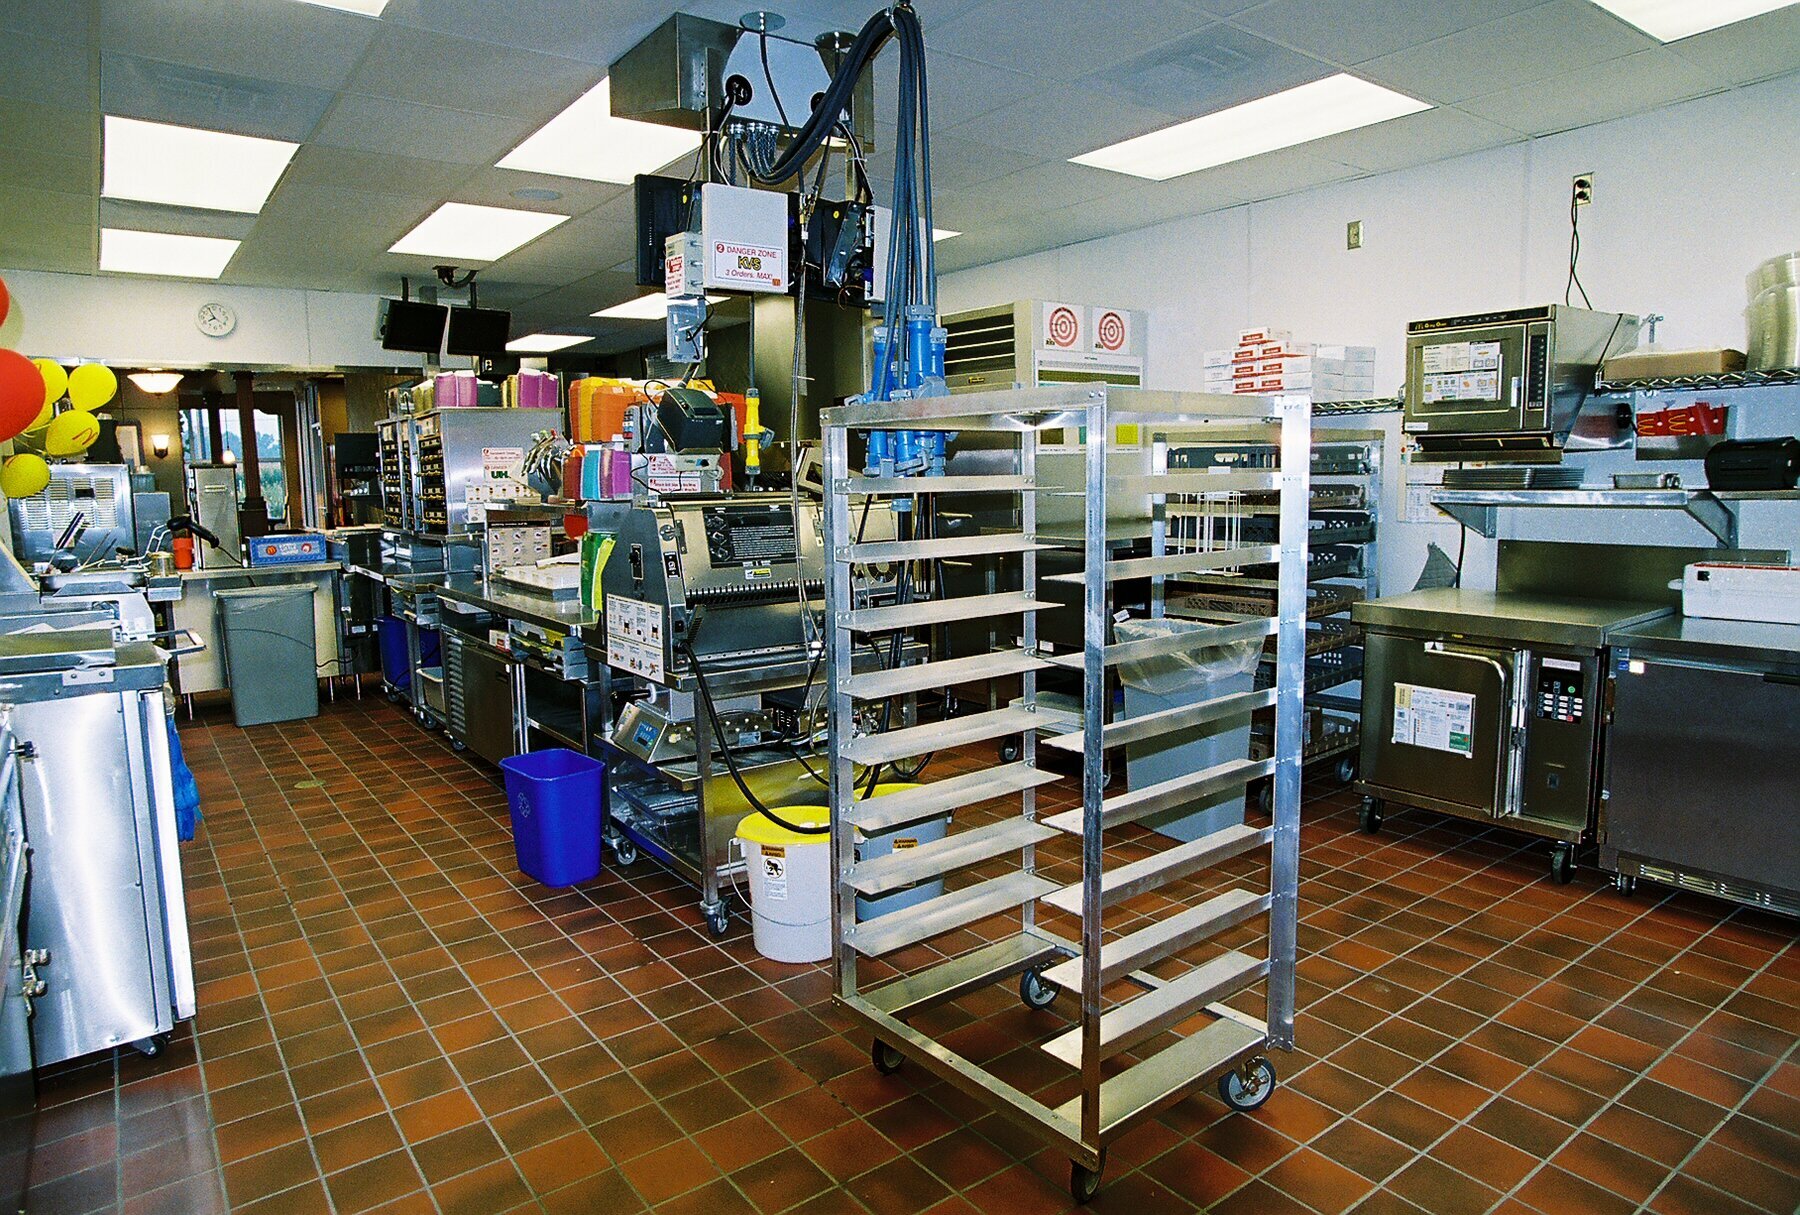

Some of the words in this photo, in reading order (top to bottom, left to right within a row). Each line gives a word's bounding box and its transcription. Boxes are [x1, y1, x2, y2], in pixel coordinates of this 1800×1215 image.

[726, 246, 757, 256] DANGER
[757, 249, 777, 259] ZONE
[737, 255, 762, 271] KVS
